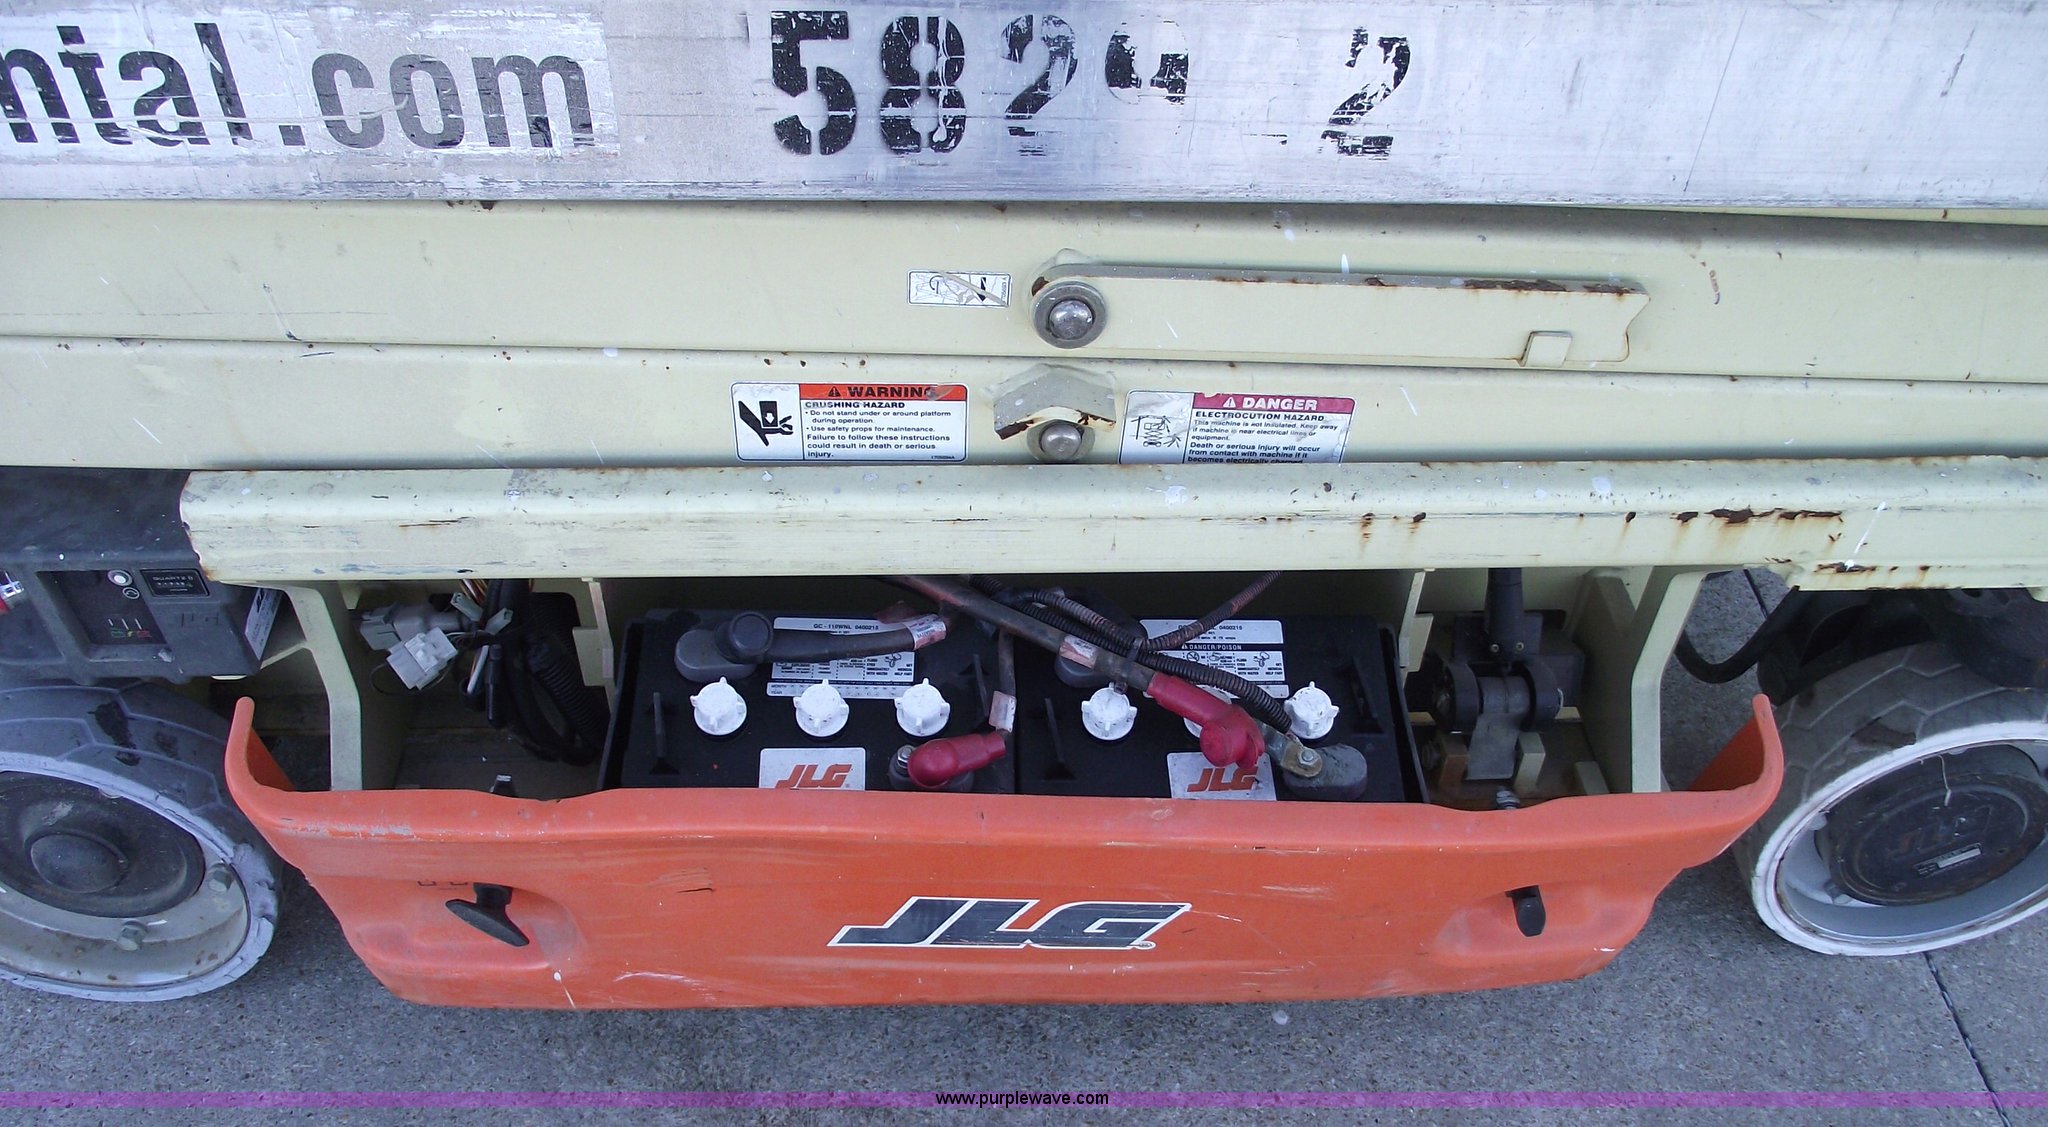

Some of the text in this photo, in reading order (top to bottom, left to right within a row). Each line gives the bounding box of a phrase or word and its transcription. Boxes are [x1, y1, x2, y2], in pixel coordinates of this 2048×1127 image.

[1242, 397, 1319, 411] DANGER
[1195, 411, 1325, 422] ELECTROCUTION HAZARD
[807, 451, 834, 459] injury.
[1257, 444, 1281, 453] injury
[774, 763, 853, 790] JLG
[1186, 767, 1259, 793] JLG
[827, 896, 1192, 949] JLG
